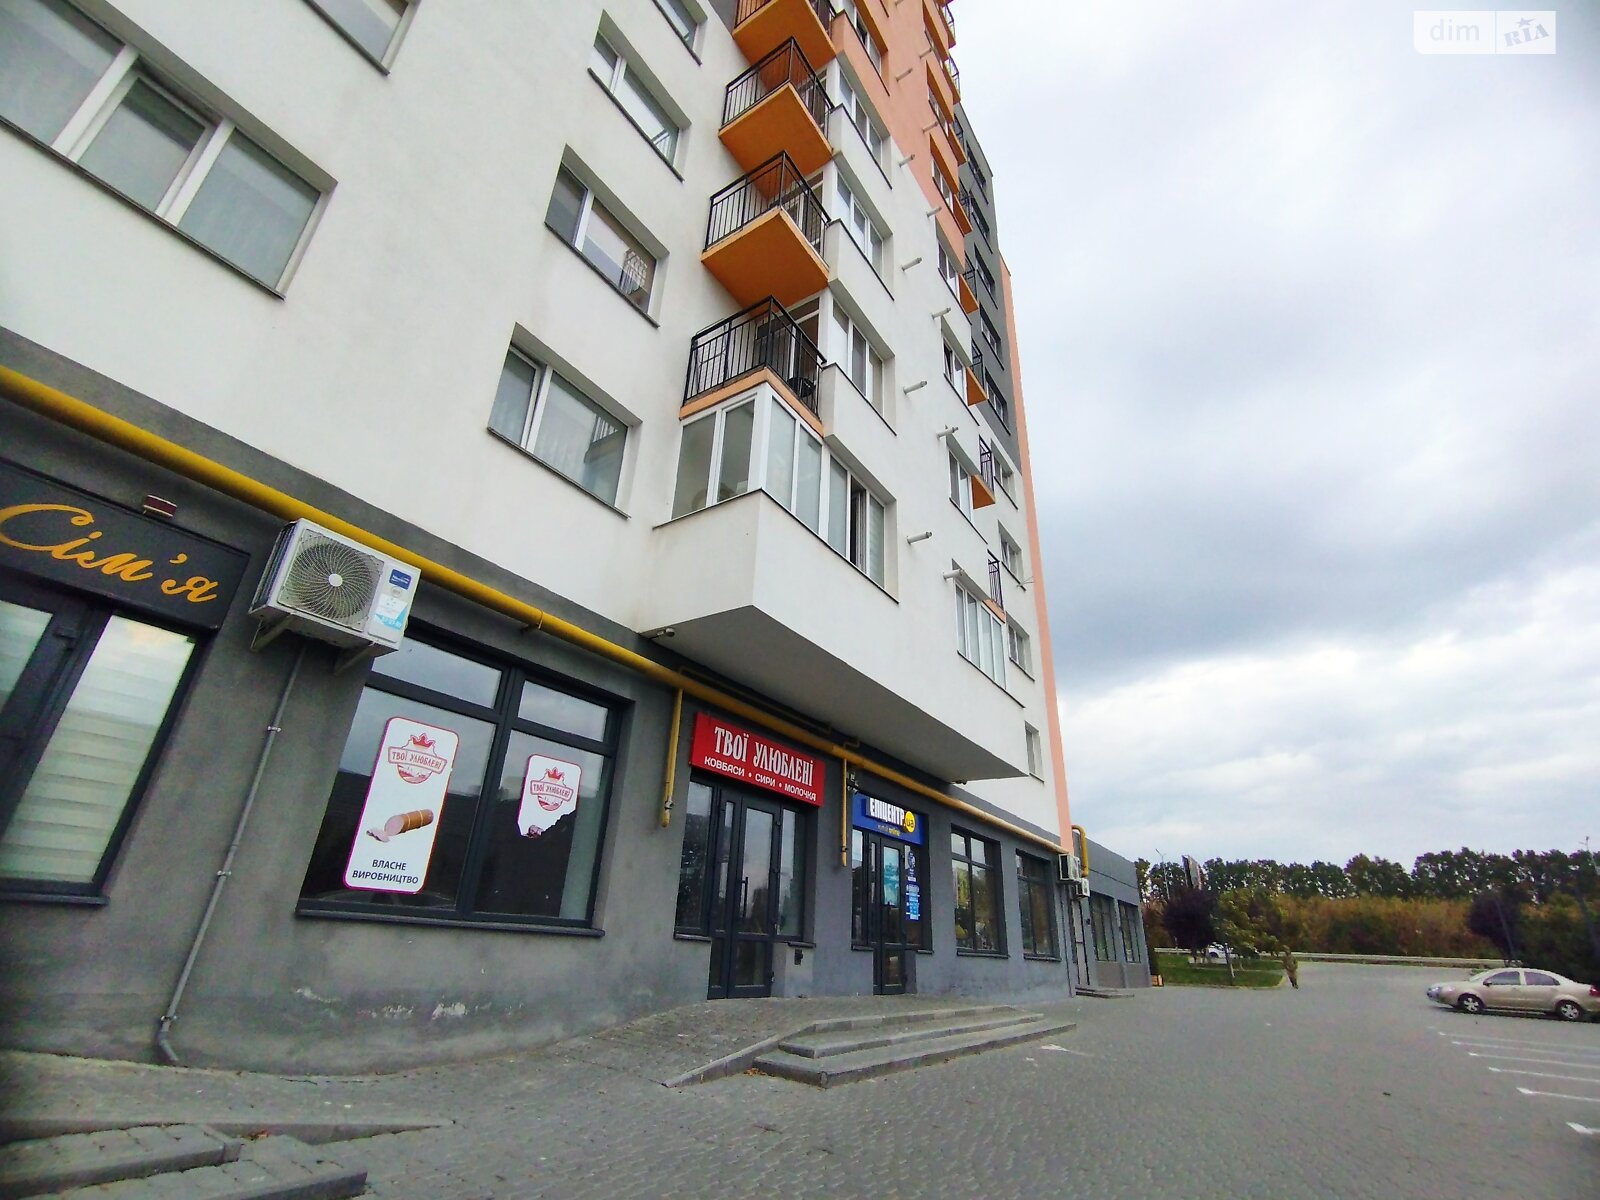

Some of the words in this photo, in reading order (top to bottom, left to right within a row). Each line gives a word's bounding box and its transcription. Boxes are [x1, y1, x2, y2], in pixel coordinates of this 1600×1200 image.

[714, 726, 750, 763] ТВОЇ
[753, 741, 814, 787] УЛЮБЛЕНІ
[704, 755, 745, 778] КОВБАСИ
[755, 773, 776, 788] СИРИ
[784, 783, 817, 802] МОЛОЧКА
[351, 869, 419, 884] ВИРОБНИЦТВО
[371, 859, 407, 871] ВЛАСНЕ
